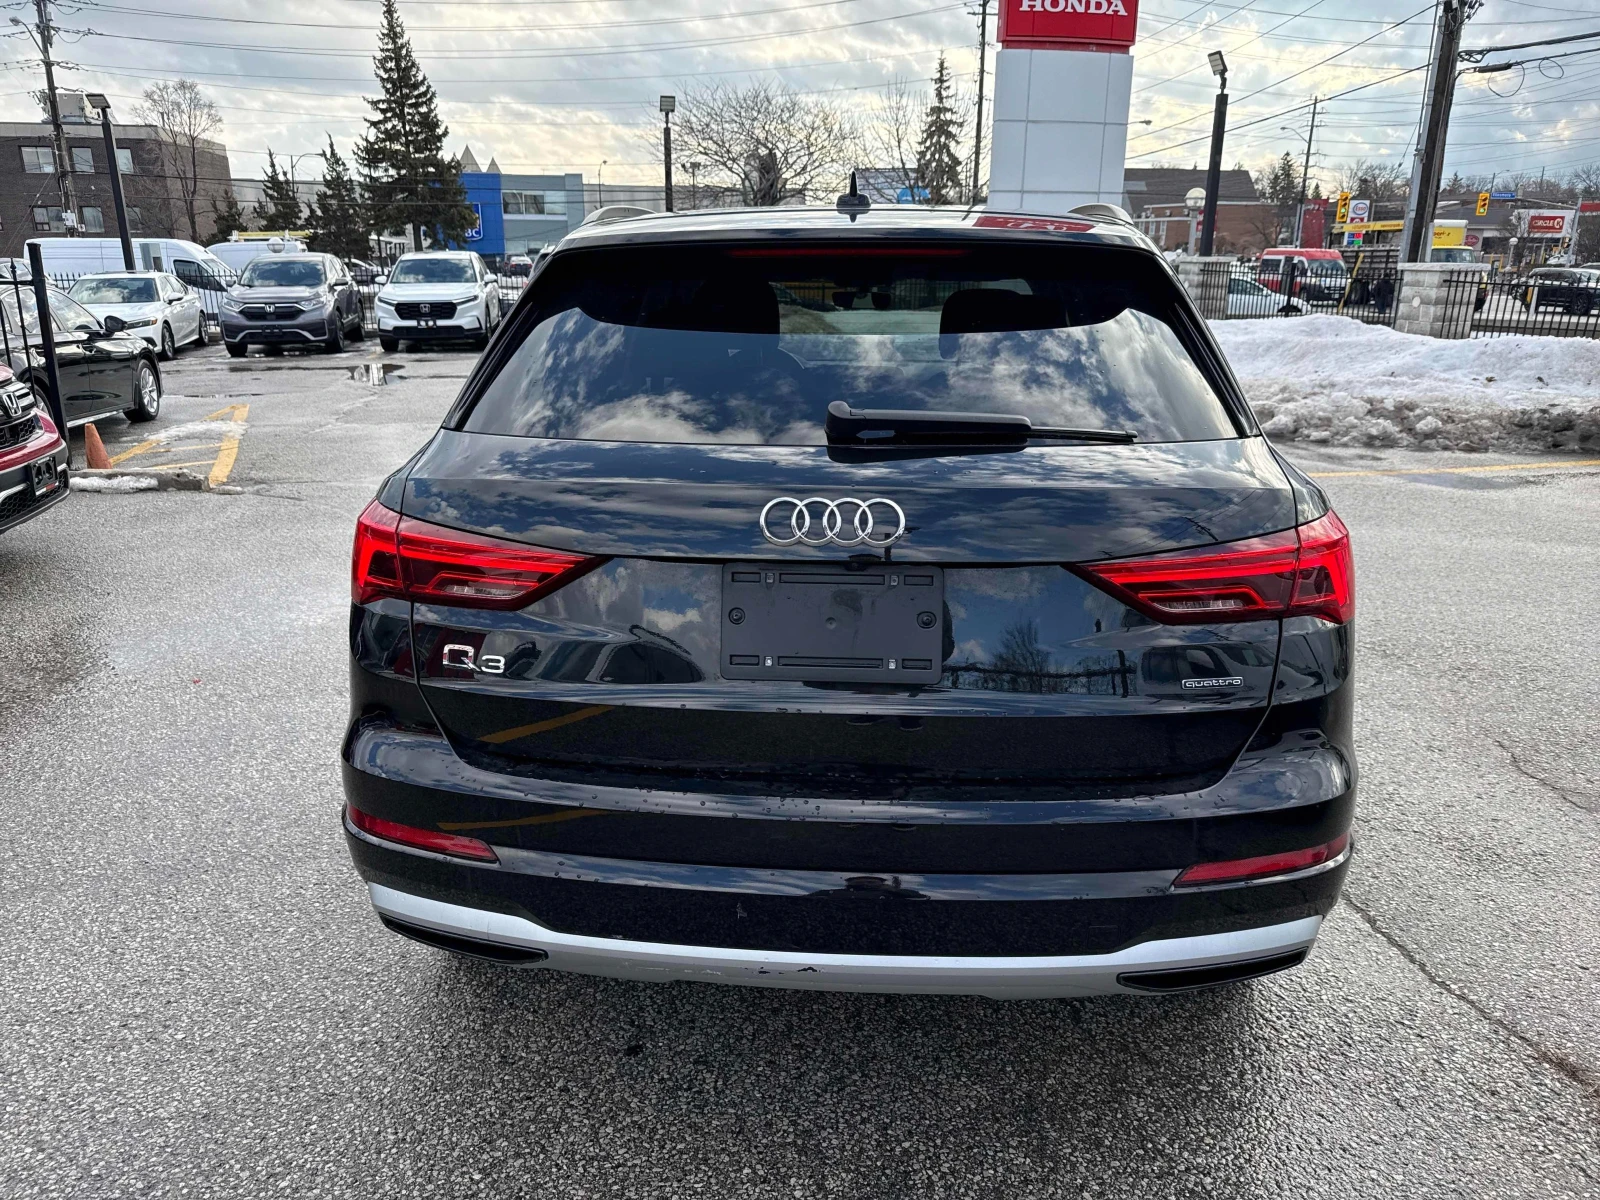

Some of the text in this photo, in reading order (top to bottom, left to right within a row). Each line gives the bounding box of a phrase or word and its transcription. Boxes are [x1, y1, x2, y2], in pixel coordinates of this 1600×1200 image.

[1018, 0, 1128, 16] HONDA
[1532, 219, 1554, 227] CIRCLE
[443, 643, 505, 674] Q3
[1185, 679, 1241, 688] quattro
